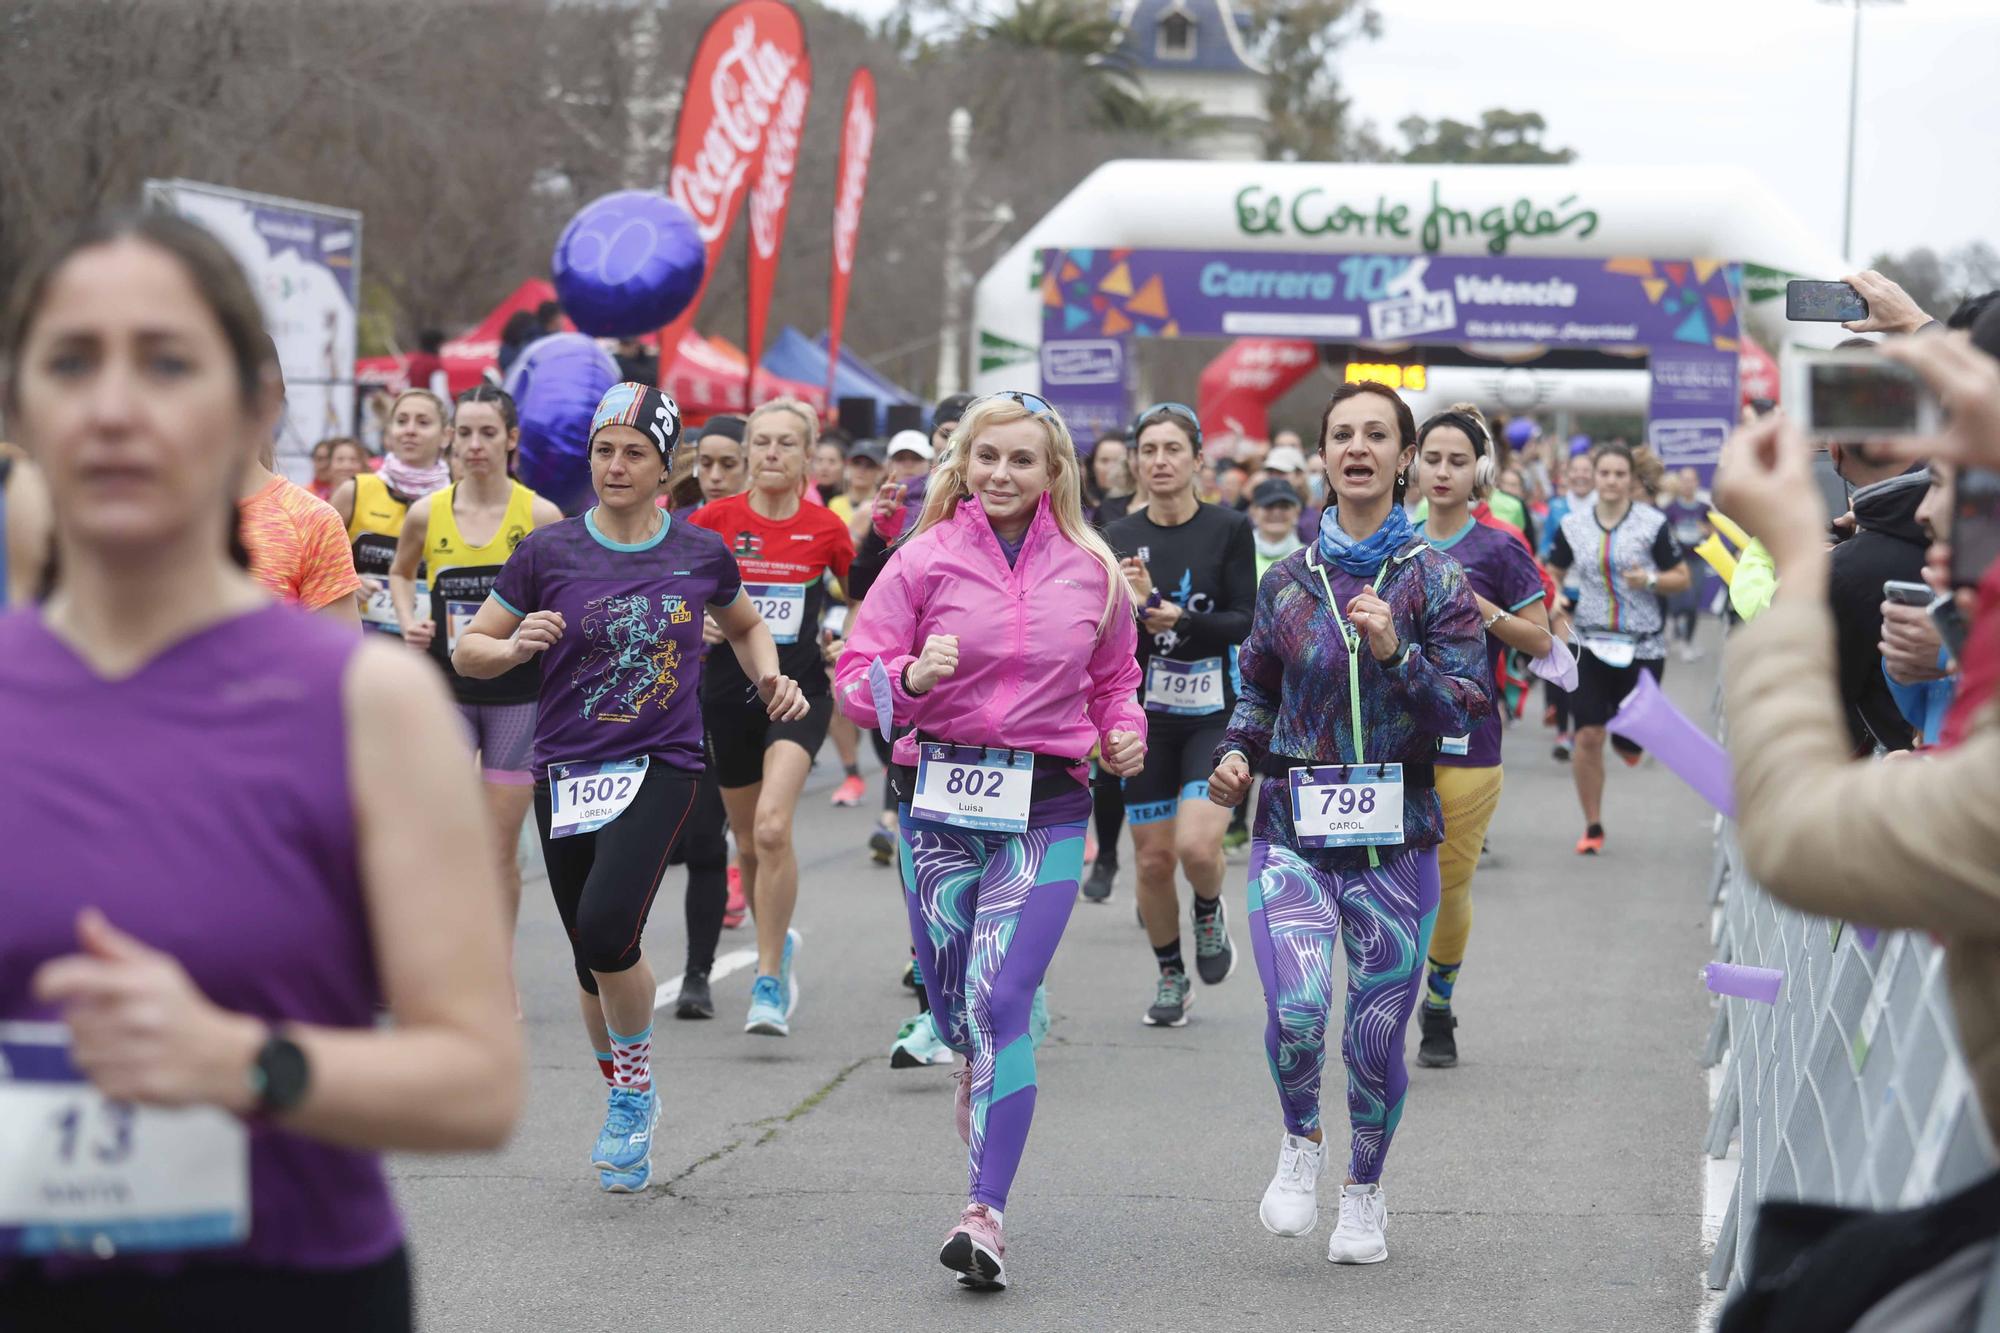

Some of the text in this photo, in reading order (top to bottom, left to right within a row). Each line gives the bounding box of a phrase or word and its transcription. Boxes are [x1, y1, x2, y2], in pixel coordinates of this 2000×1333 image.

[1235, 180, 1599, 255] El Corte Inglés
[1200, 263, 1335, 299] Carrera
[1454, 274, 1577, 307] Valencia
[1162, 674, 1211, 694] 1916
[568, 776, 632, 806] 1502
[946, 767, 1004, 798] 802
[958, 802, 984, 813] Luisa
[1133, 804, 1172, 820] TEAM
[1320, 787, 1376, 815] 798
[580, 808, 613, 819] LORENA
[1329, 821, 1365, 831] CAROL
